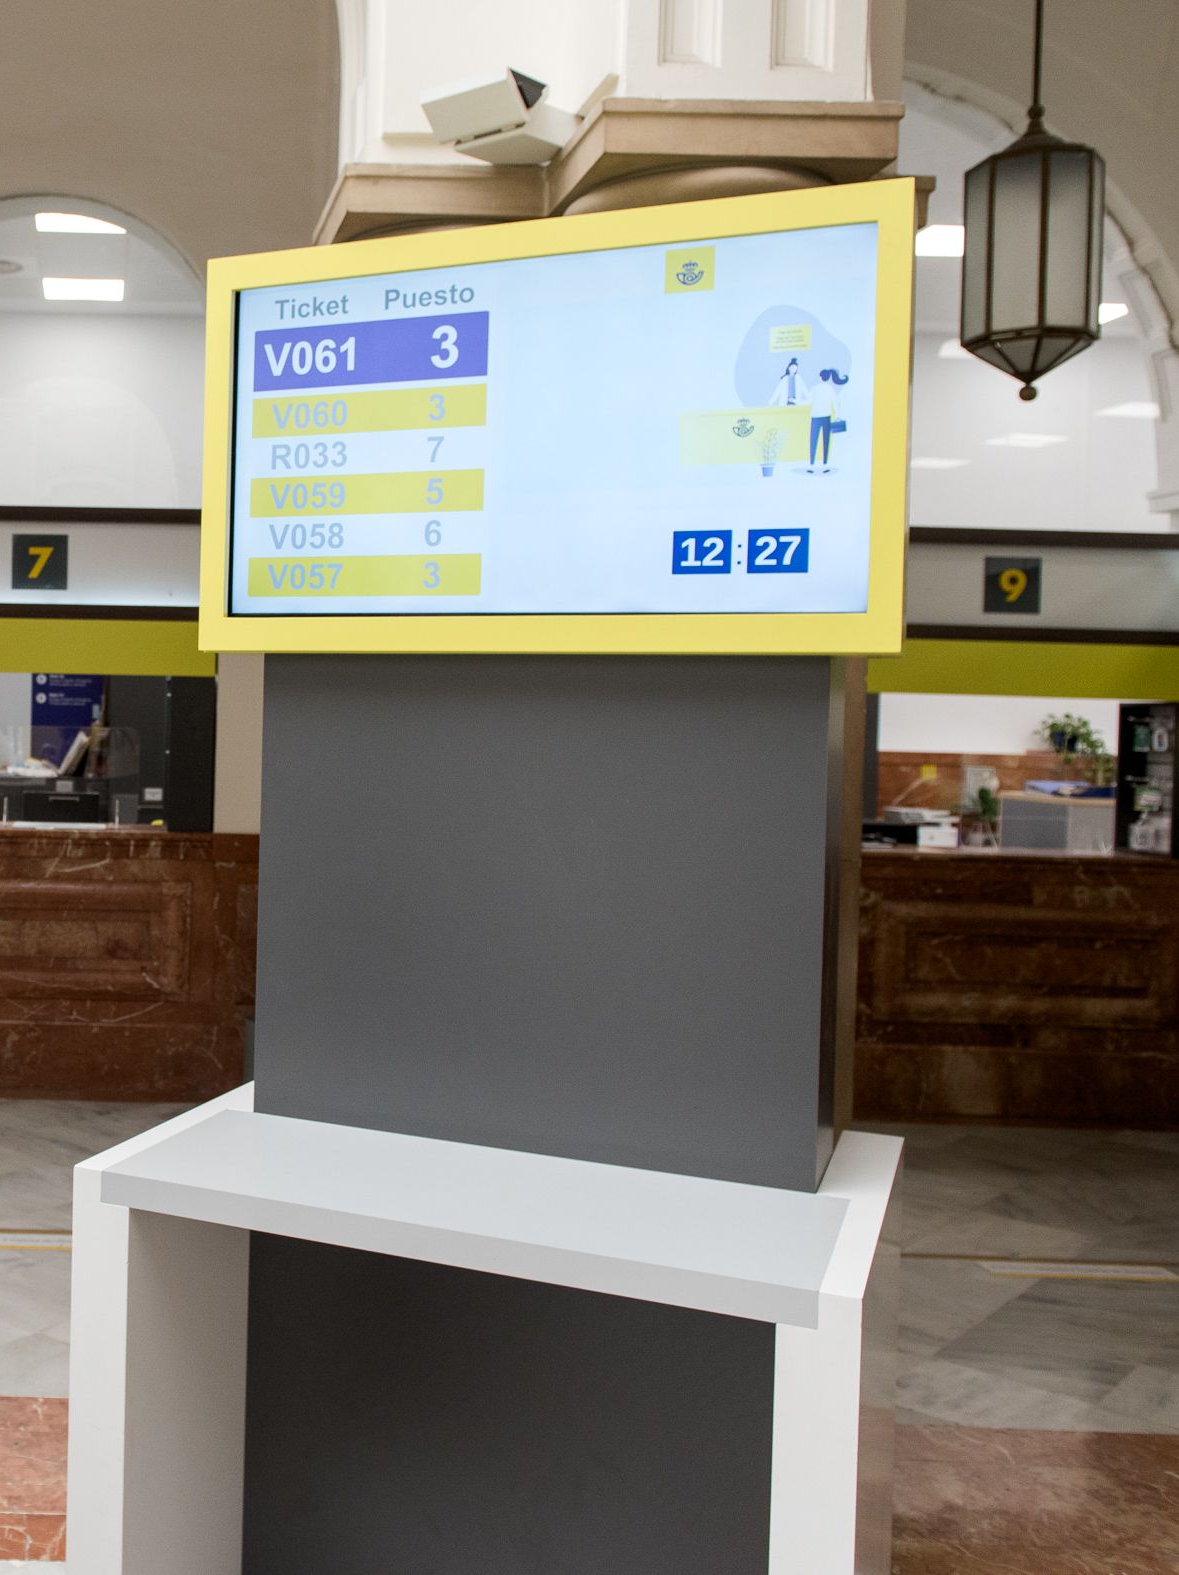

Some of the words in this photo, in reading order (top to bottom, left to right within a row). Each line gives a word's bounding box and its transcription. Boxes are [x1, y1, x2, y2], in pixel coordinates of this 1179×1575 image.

[275, 295, 349, 320] Ticket
[384, 284, 475, 310] Puesto
[264, 336, 356, 377] V061
[430, 325, 460, 369] 3
[272, 400, 348, 430] V060
[428, 393, 446, 421] 3
[271, 441, 347, 470] R033
[427, 436, 445, 463] 7
[270, 482, 346, 510] V059
[426, 478, 444, 506] 5
[269, 523, 344, 550] V058
[424, 520, 442, 547] 6
[28, 546, 54, 579] 7
[268, 563, 343, 590] V057
[423, 562, 441, 589] 3
[998, 567, 1028, 603] 9
